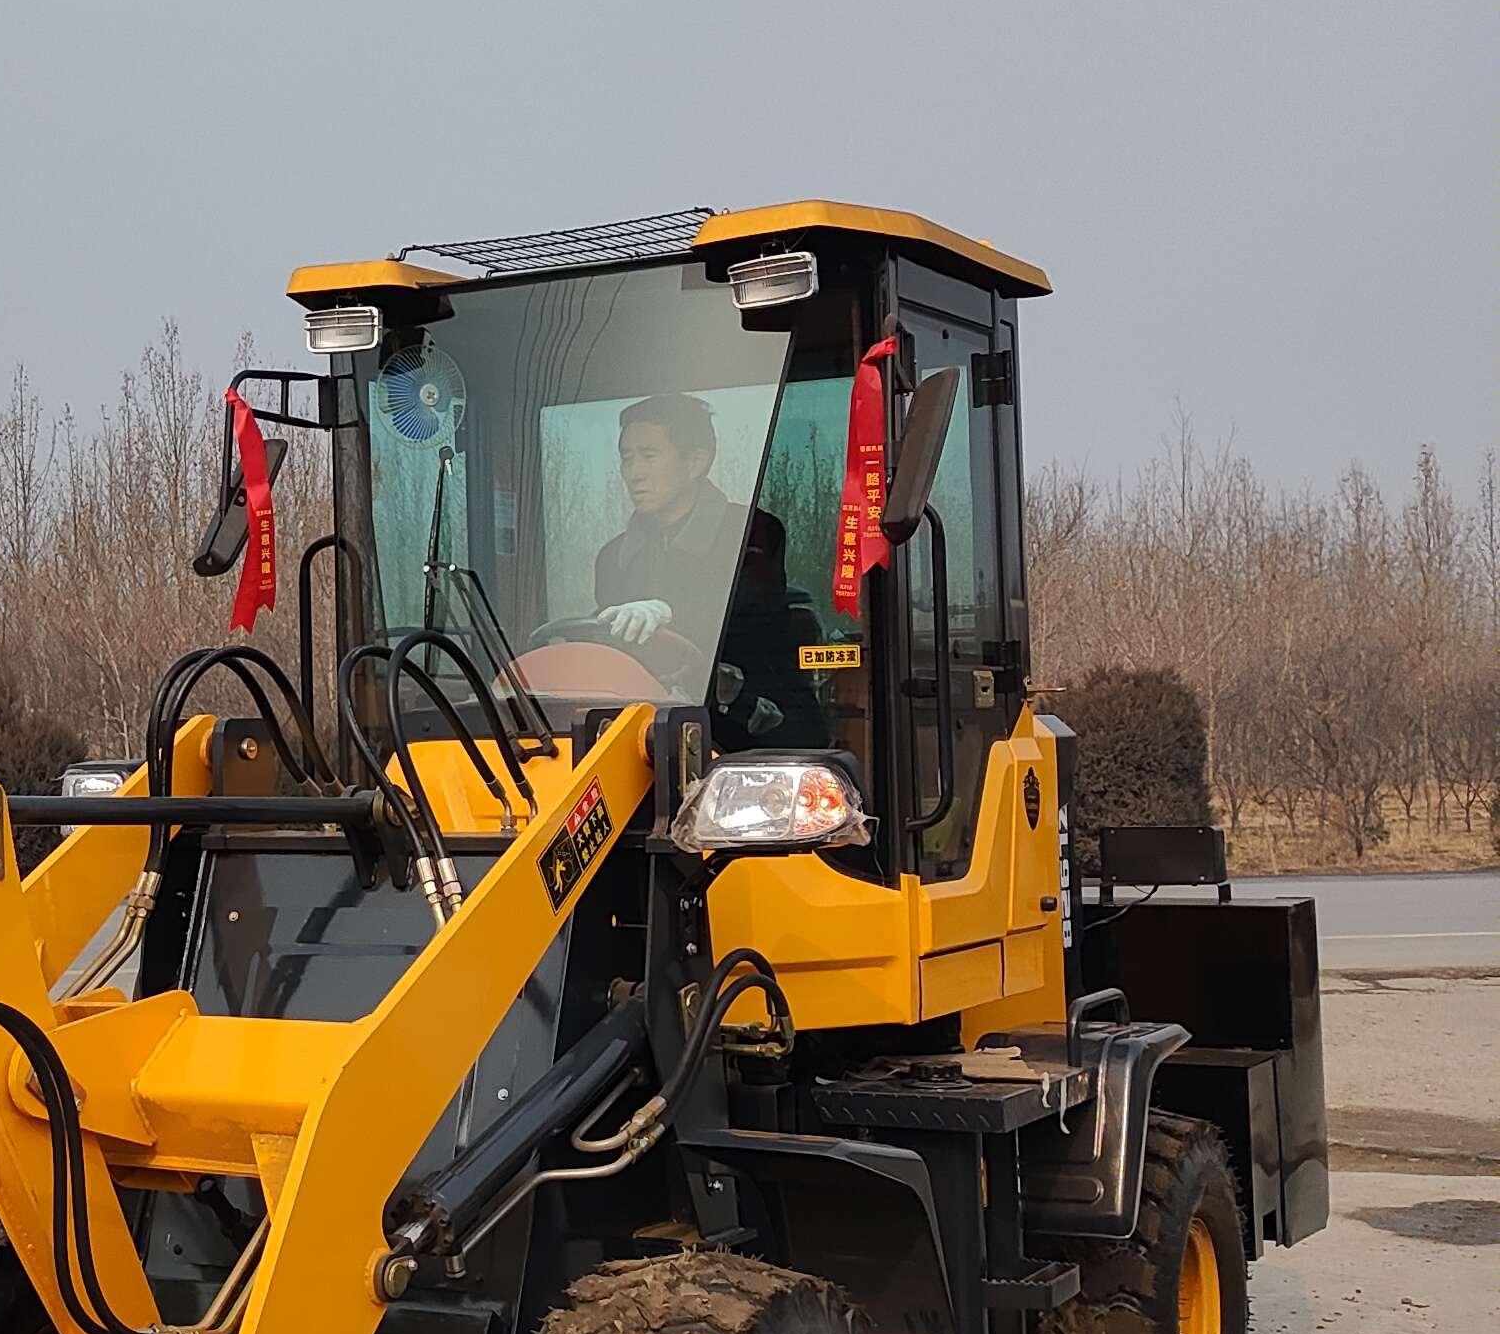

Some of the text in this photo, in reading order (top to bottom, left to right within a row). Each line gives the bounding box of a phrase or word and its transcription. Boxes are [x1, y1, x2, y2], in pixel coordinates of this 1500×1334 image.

[865, 460, 881, 520] 一路平安
[261, 520, 271, 574] 生意兴隆
[841, 516, 859, 579] 生意兴隆
[804, 650, 856, 663] 已加防冻液
